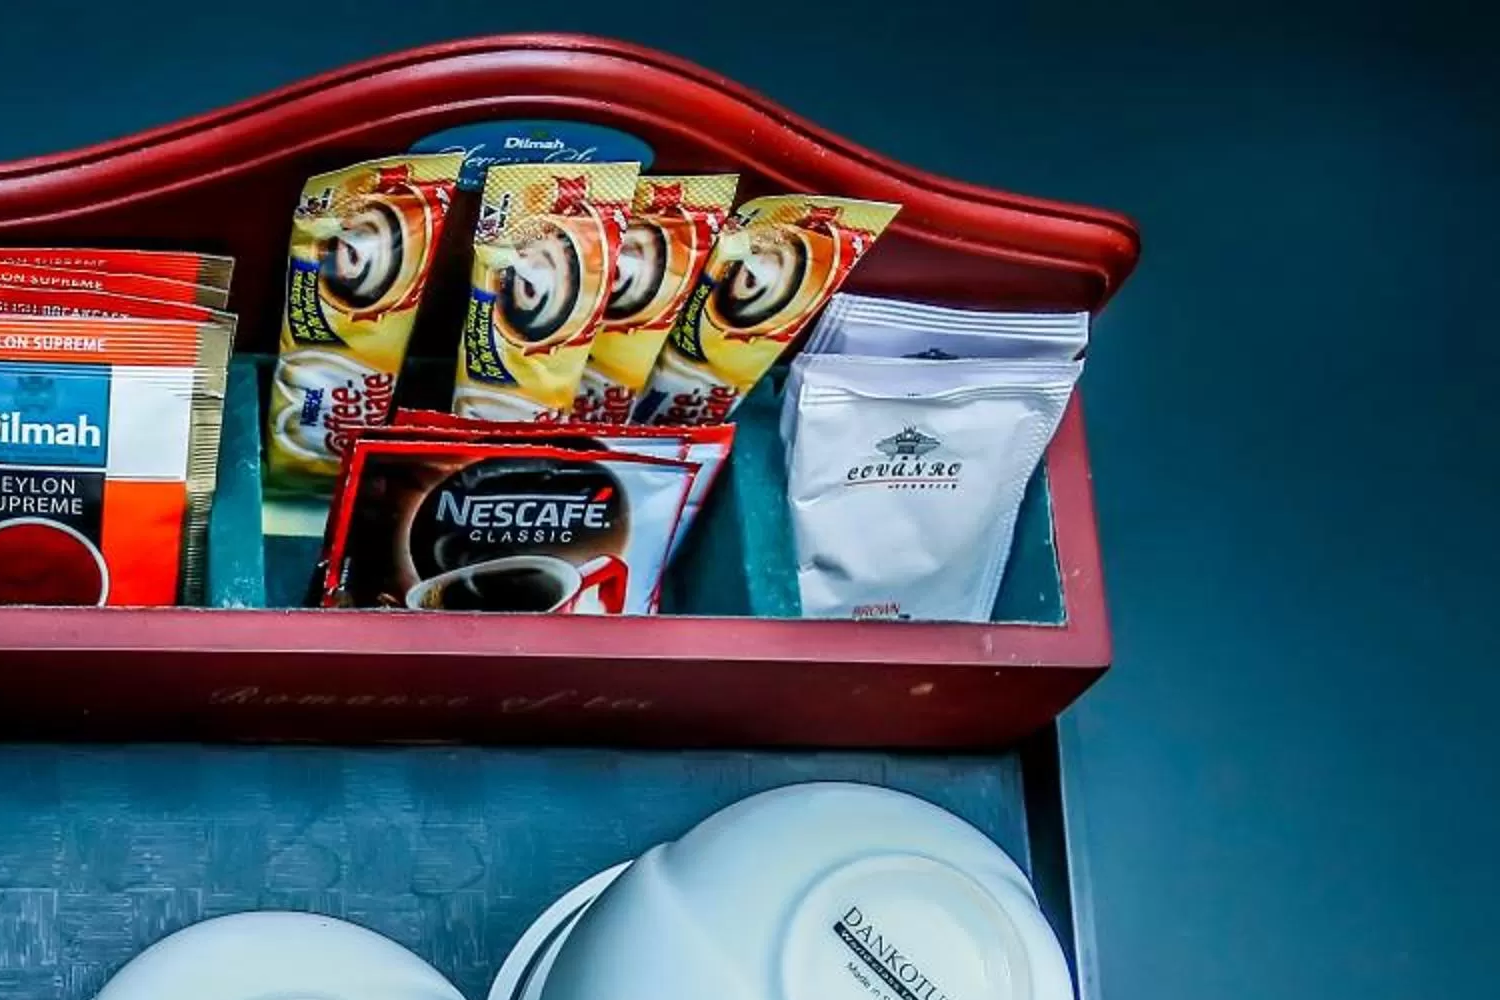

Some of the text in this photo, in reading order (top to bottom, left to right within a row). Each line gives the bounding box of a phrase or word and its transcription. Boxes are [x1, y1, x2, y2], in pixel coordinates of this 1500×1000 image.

[503, 137, 564, 150] Dilmah
[30, 276, 104, 290] SUPREME
[30, 337, 107, 353] SUPREME
[469, 529, 574, 544] CLASSIC
[847, 961, 871, 988] Made
